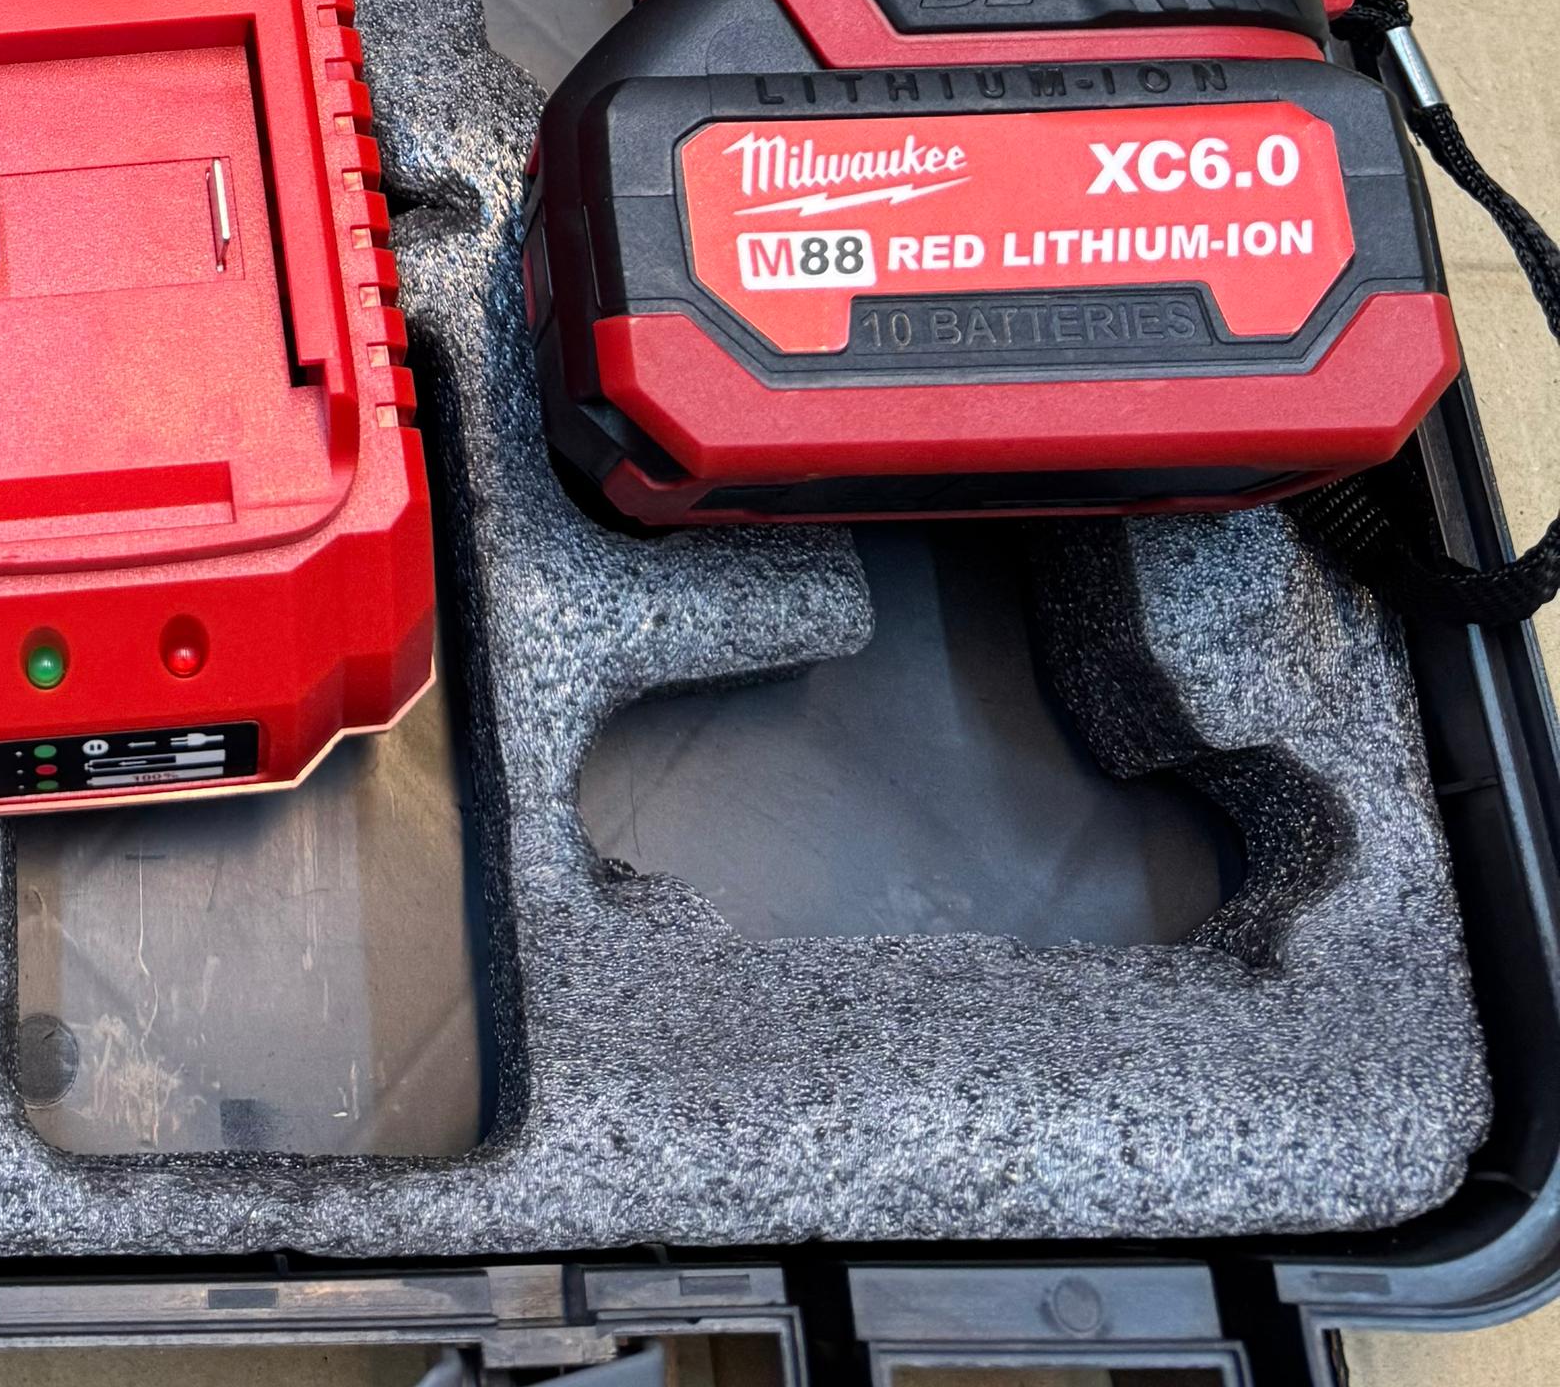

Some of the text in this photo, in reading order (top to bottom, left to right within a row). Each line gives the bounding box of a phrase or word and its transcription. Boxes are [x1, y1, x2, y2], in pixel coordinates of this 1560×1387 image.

[755, 62, 1229, 105] LITHIUM-ION
[721, 130, 1302, 198] Milwaukee XC6.0
[747, 218, 1315, 279] M88 RED LITHIUM-ION
[861, 301, 1197, 348] 10 BATTERIES
